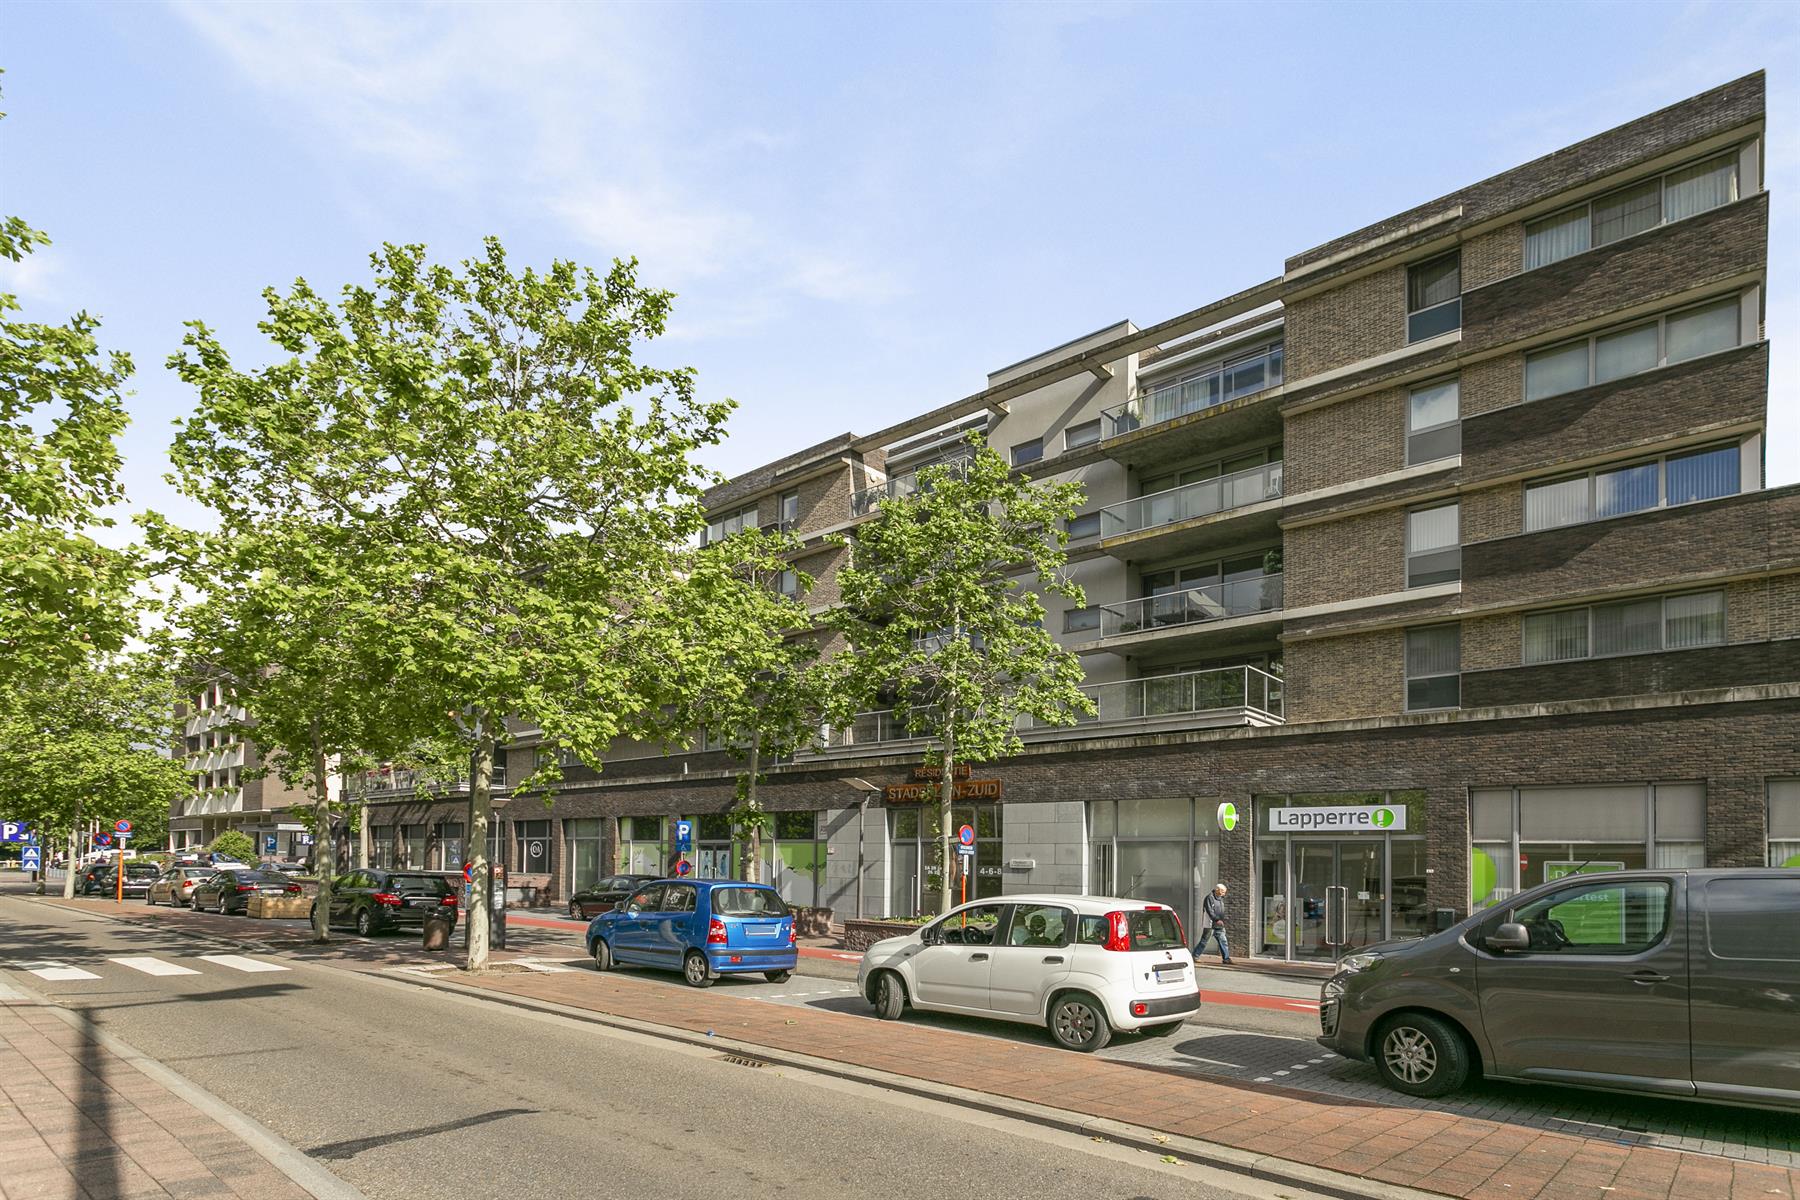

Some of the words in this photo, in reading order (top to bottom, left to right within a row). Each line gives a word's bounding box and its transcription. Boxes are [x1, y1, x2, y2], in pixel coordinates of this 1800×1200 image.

[915, 766, 968, 777] RESIDTIE
[1278, 810, 1370, 829] Lapperre
[3, 824, 18, 840] P
[679, 824, 690, 840] P
[267, 836, 276, 847] P
